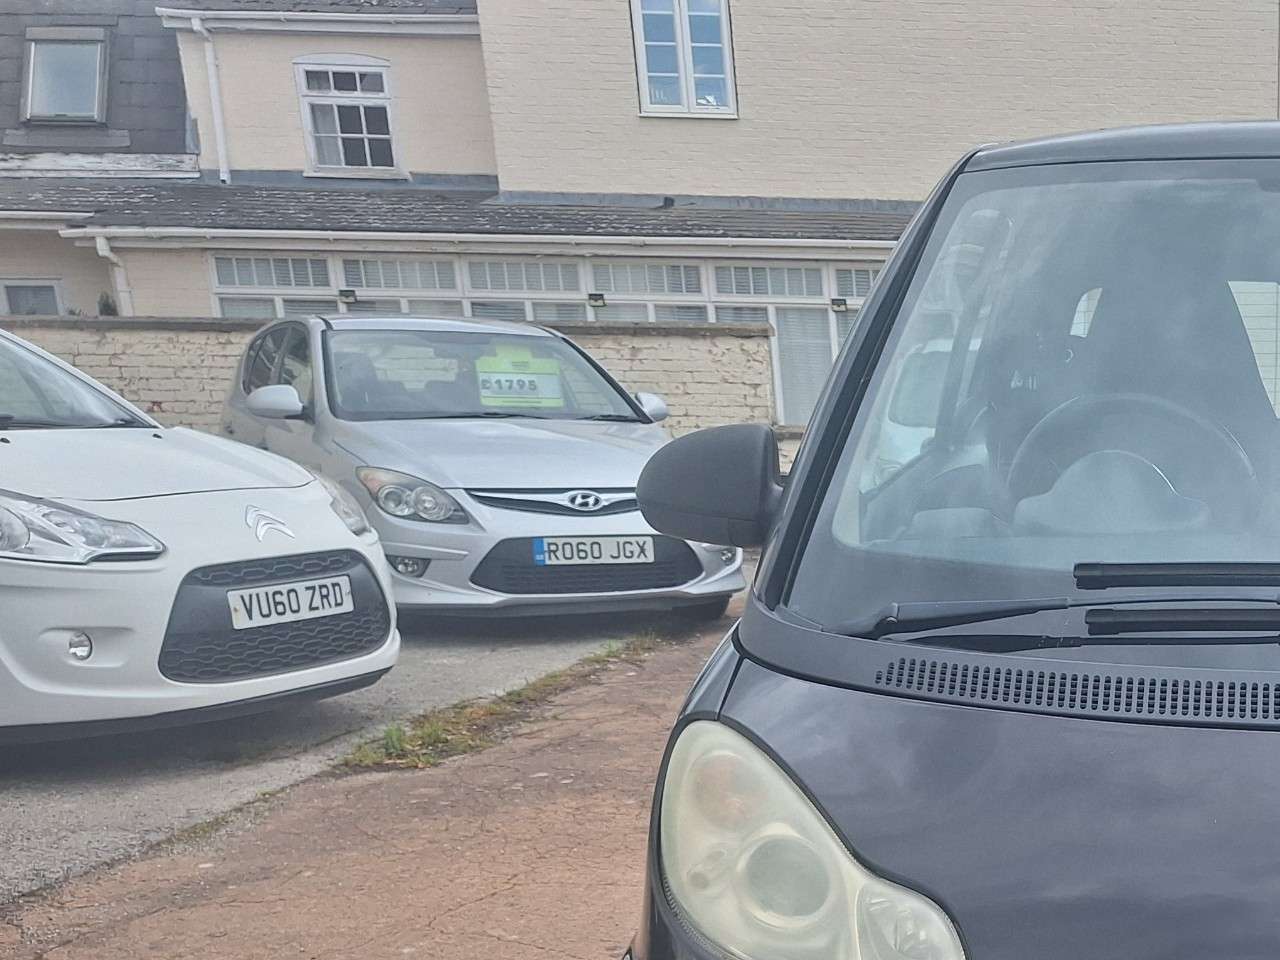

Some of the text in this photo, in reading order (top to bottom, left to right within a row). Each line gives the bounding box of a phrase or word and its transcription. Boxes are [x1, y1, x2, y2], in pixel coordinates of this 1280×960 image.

[547, 541, 648, 560] RO60 JGX
[240, 582, 344, 621] VU60 ZRD
